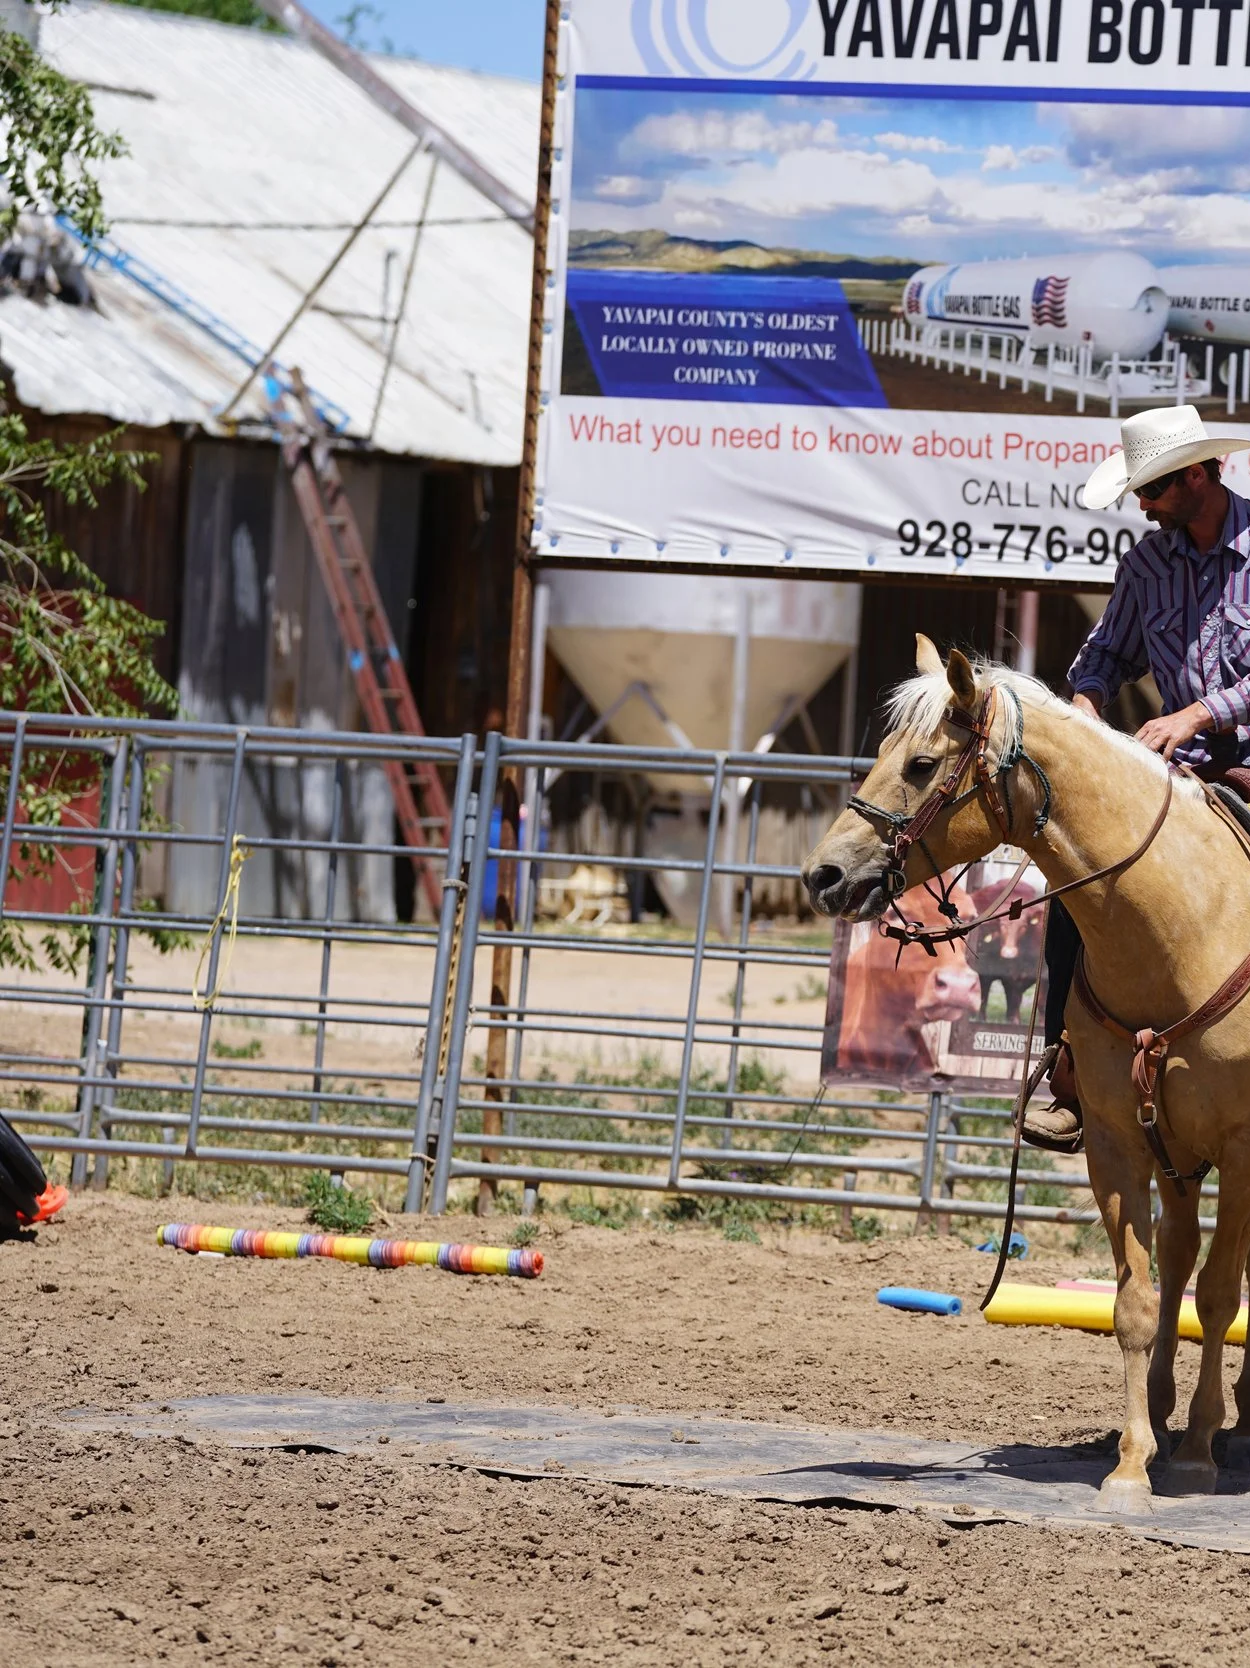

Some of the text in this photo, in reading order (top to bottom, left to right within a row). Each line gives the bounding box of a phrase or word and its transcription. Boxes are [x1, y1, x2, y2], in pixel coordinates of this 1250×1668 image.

[817, 0, 1061, 62] YAVAPAI
[602, 305, 839, 332] YAVAPAI COUNTY'S OLDEST
[601, 335, 837, 361] LOCALLY OWNED PROPANE
[673, 366, 760, 386] COMPANY
[569, 414, 641, 443] What
[651, 424, 701, 452] you
[711, 420, 781, 450] need
[791, 422, 818, 452] to
[828, 423, 902, 456] know
[912, 429, 994, 459] about
[961, 479, 1042, 509] CALL
[898, 519, 1155, 565] 928-776-90
[974, 1032, 1027, 1053] SERVING
